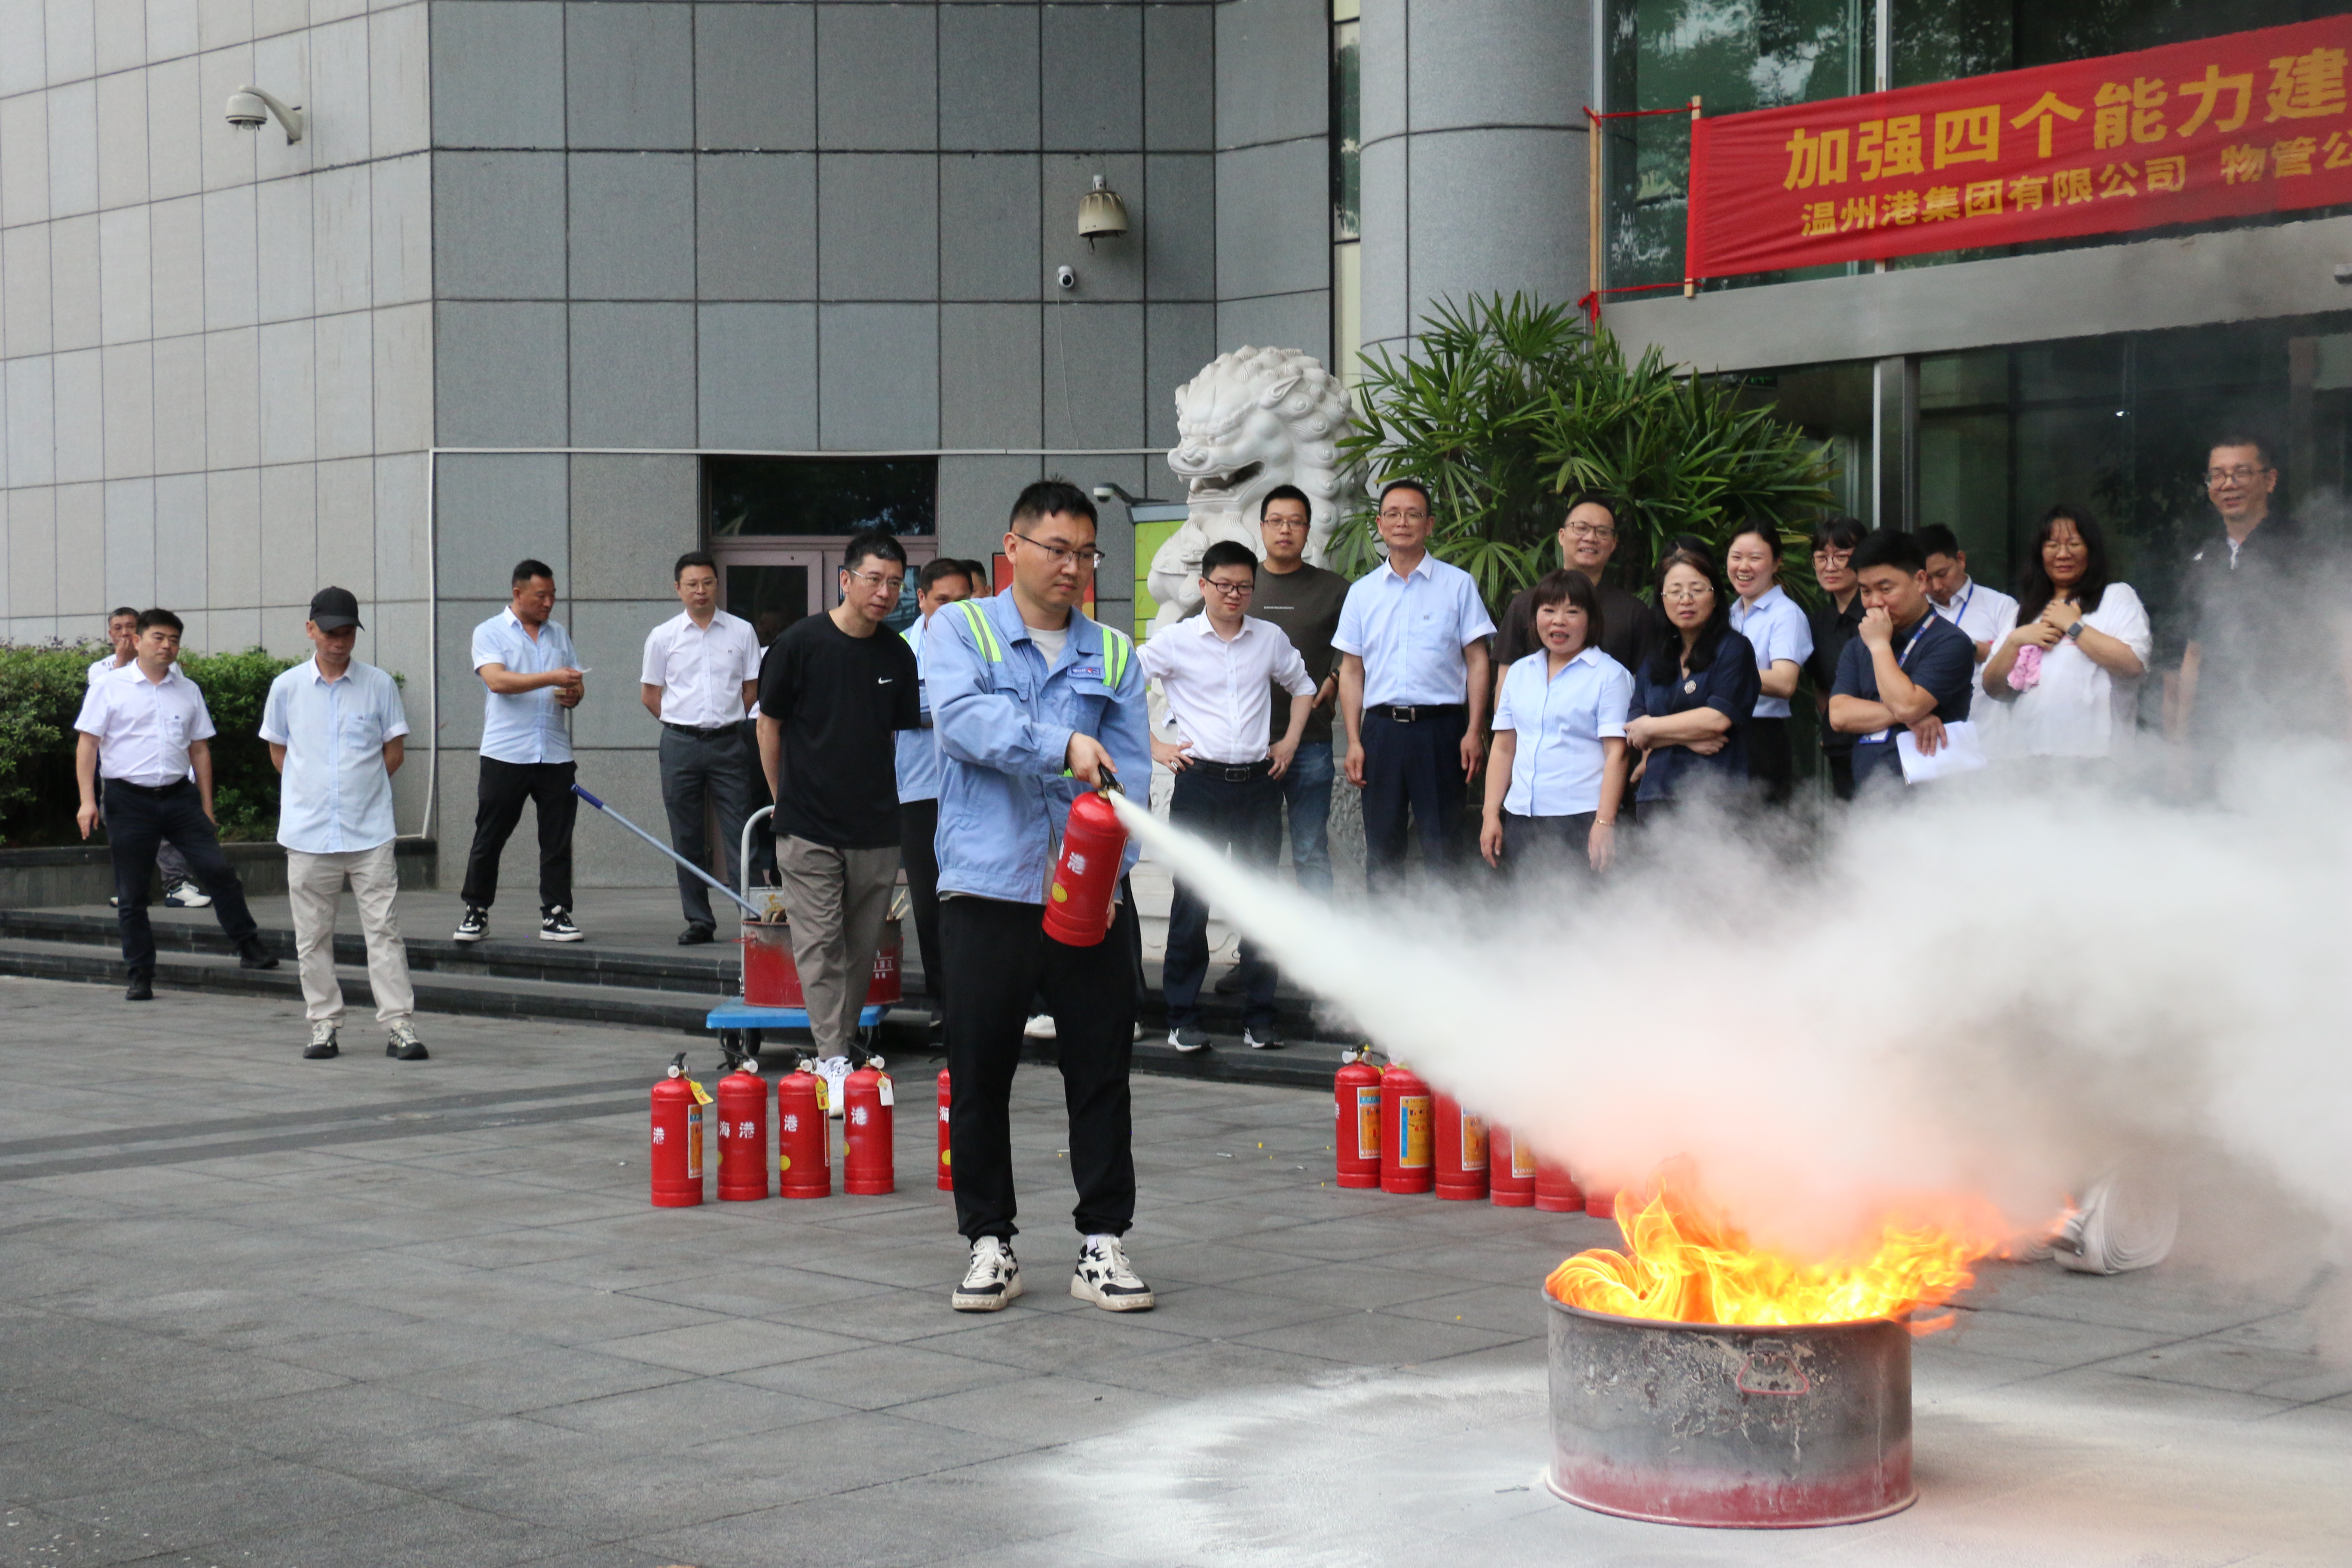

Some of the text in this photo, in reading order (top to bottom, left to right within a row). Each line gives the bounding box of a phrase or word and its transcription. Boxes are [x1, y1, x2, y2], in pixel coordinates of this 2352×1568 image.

[1783, 47, 2349, 190] 加强四个能力建
[1801, 130, 2352, 236] 温州港集团有限公司 物管公
[653, 1126, 665, 1145] 港
[784, 1115, 798, 1132] 港
